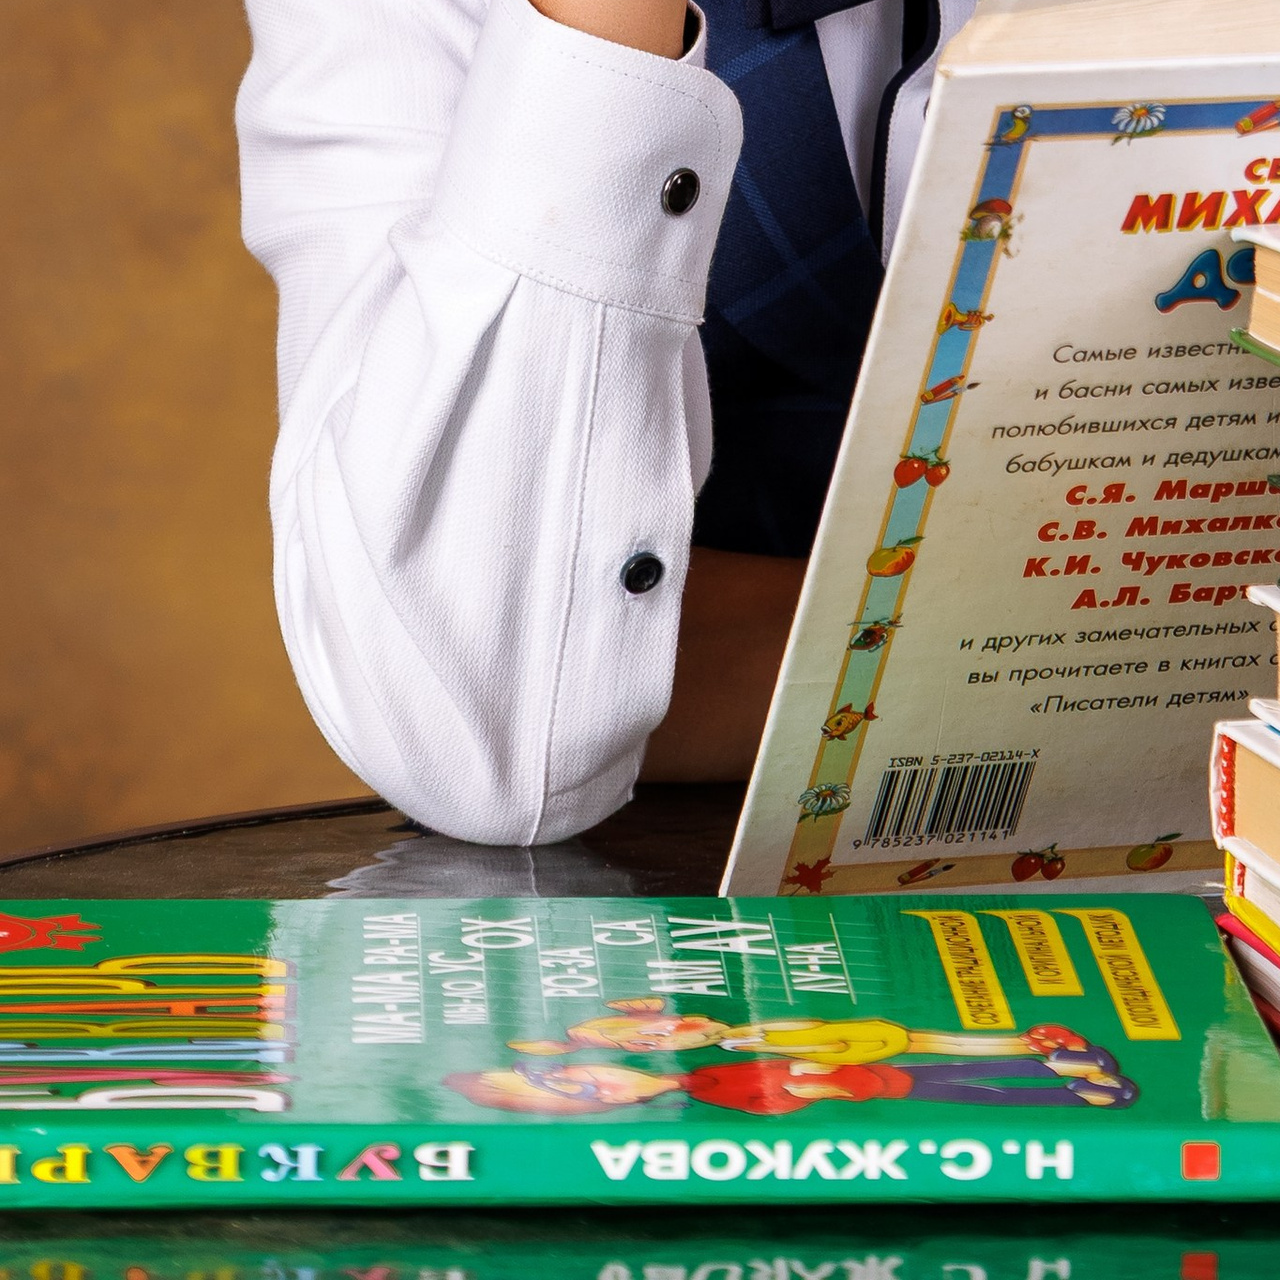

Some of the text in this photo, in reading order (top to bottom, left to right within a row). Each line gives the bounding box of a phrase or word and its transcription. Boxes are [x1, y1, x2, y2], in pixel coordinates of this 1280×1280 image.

[1053, 344, 1136, 364] Самые
[1035, 388, 1048, 401] и
[1058, 380, 1131, 400] басни
[1142, 378, 1219, 395] самых
[991, 415, 1176, 440] полюбившихся
[1185, 413, 1257, 431] детям
[1266, 410, 1280, 424] и
[1005, 453, 1132, 477] бабушкам
[1142, 453, 1155, 466] и
[1065, 483, 1136, 506] С.Я.
[1037, 520, 1108, 542] С.В.
[1023, 554, 1101, 578] К.И.
[1071, 582, 1250, 610] А.Л. Барт
[959, 638, 973, 651] и
[981, 633, 1065, 653] других
[1074, 620, 1260, 643] замечательных
[967, 670, 999, 684] вы
[1008, 660, 1148, 685] прочитаете
[1158, 660, 1170, 672] в
[1180, 653, 1261, 670] книгах
[1030, 688, 1249, 714] «Писатели детям»
[888, 756, 923, 769] ISBN
[460, 917, 535, 949] ОХ
[592, 919, 655, 946] СА
[667, 917, 777, 956] АУ
[351, 913, 425, 1044] МА-МА РА-МА
[540, 946, 600, 998] РО-ЗА
[646, 960, 729, 997] АМ
[784, 943, 850, 994] ЛУ-НА
[427, 950, 489, 1025] МЫ-ЛО УС
